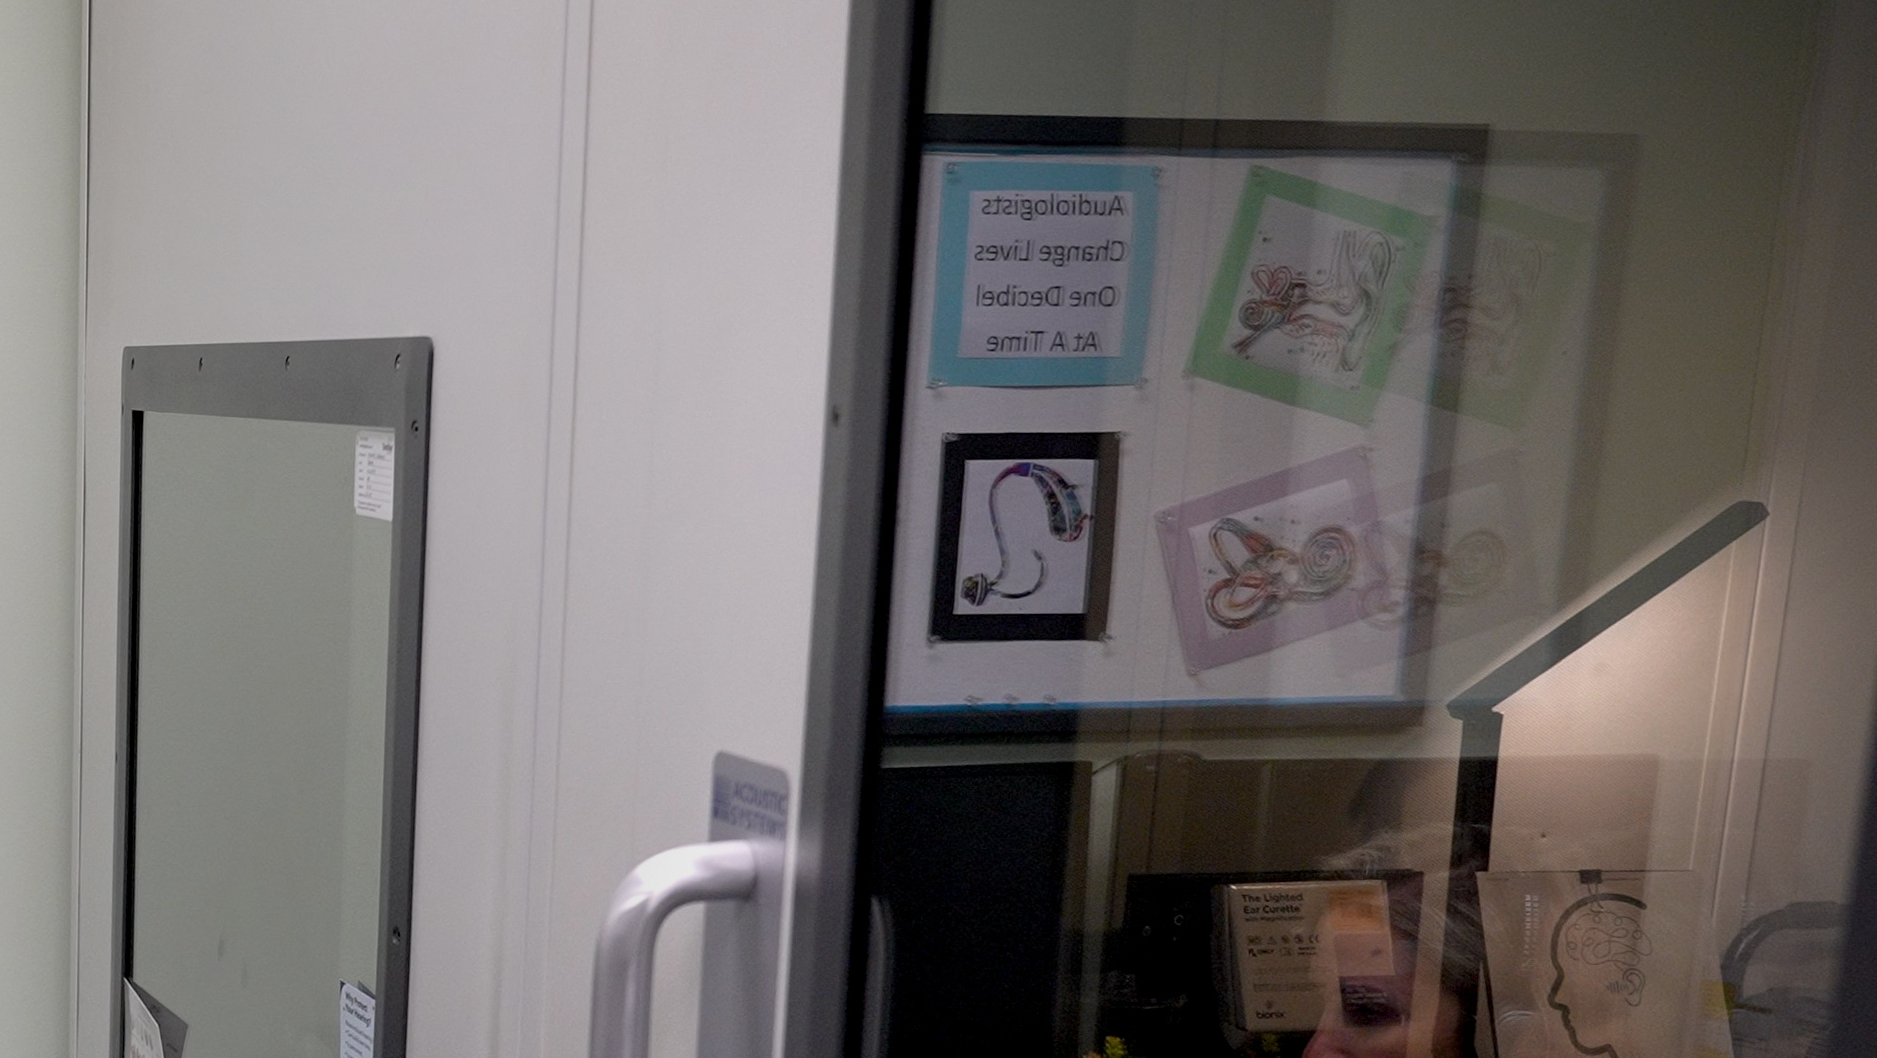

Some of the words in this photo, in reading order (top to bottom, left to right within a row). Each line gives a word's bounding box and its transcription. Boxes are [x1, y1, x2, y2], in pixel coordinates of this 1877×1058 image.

[1241, 894, 1261, 902] The
[1263, 893, 1304, 903] Lighted
[1243, 905, 1260, 914] Ear
[1262, 904, 1301, 914] Curette
